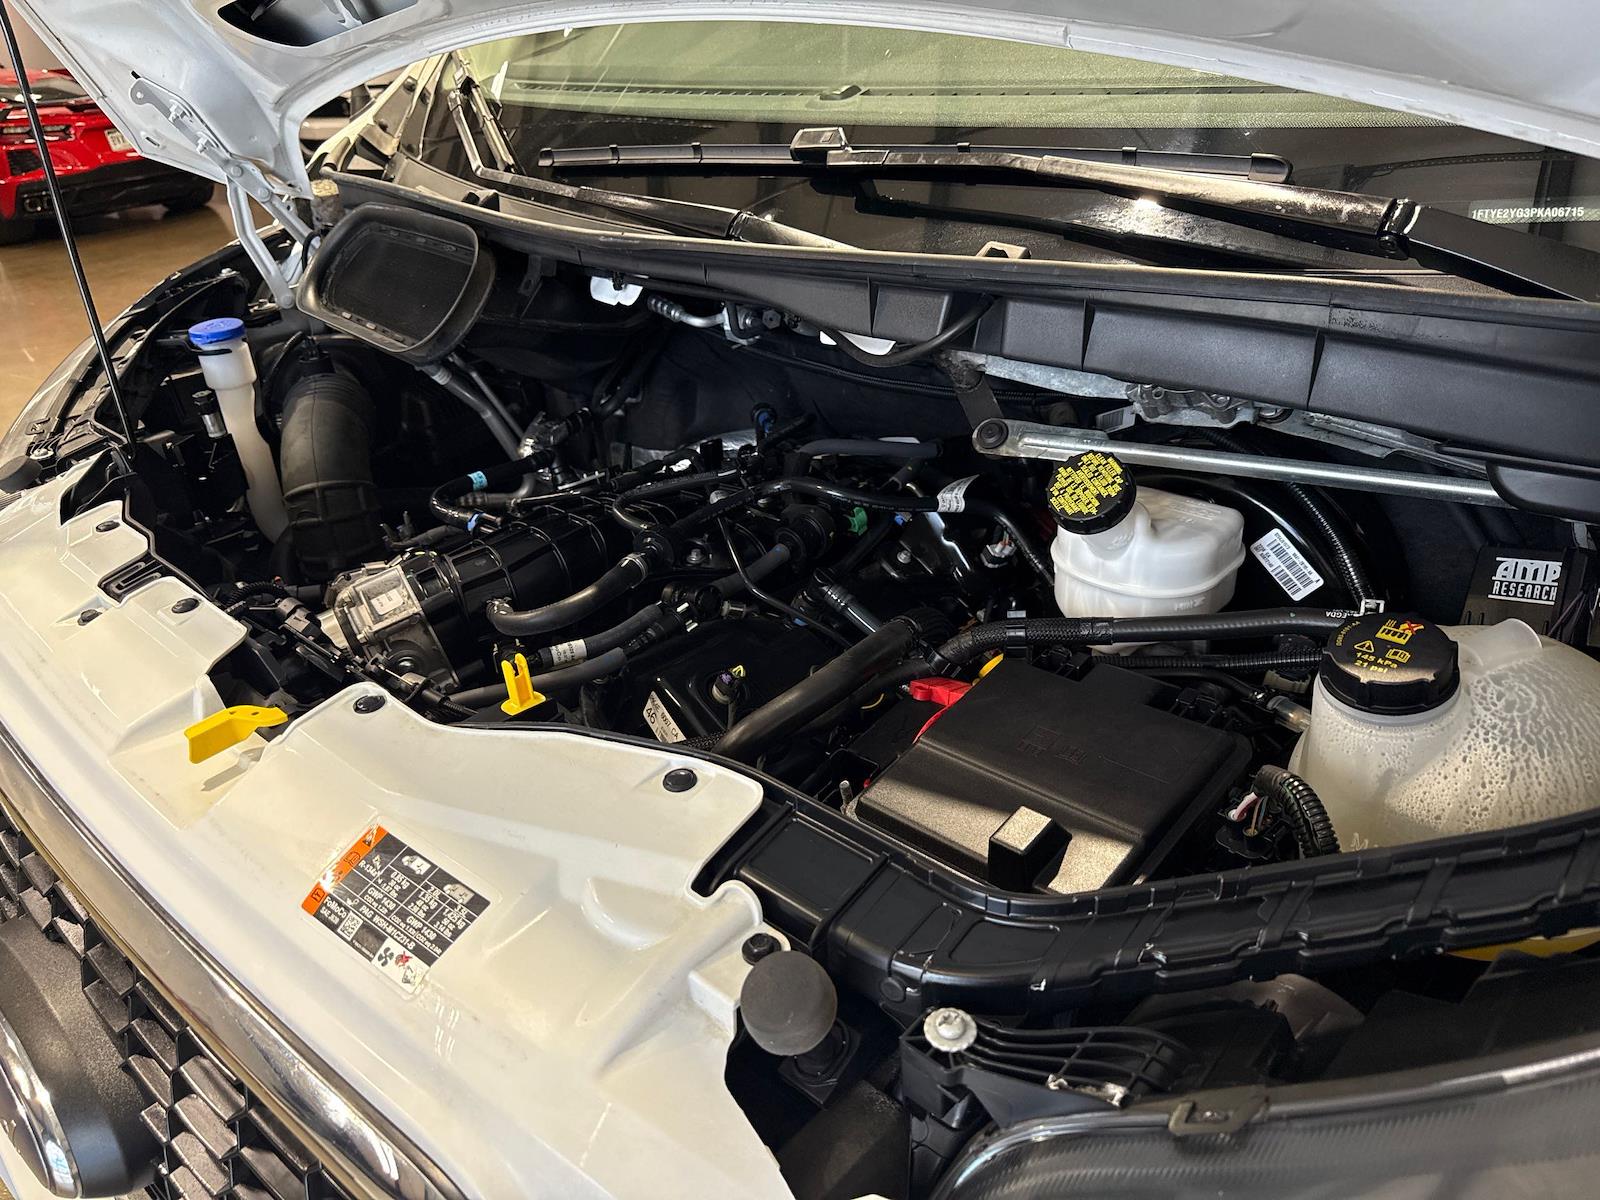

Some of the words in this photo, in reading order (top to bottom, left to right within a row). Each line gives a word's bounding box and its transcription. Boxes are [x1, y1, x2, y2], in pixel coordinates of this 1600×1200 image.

[1472, 206, 1584, 220] 1FTYE2YG3PKA06715
[1492, 581, 1558, 600] RESEARCH
[1356, 652, 1375, 662] 145
[1377, 658, 1398, 669] kPa
[1370, 666, 1388, 674] psi
[646, 708, 656, 724] 46
[357, 859, 379, 877] R-134a
[366, 886, 384, 901] GWP
[380, 896, 396, 910] 1430
[417, 890, 432, 903] 1.35
[427, 886, 442, 898] 2.0L
[323, 896, 349, 918] FoMoCo
[359, 905, 374, 918] PAG
[441, 908, 459, 922] 1.425
[405, 915, 423, 930] GWP
[419, 926, 437, 940] 1430
